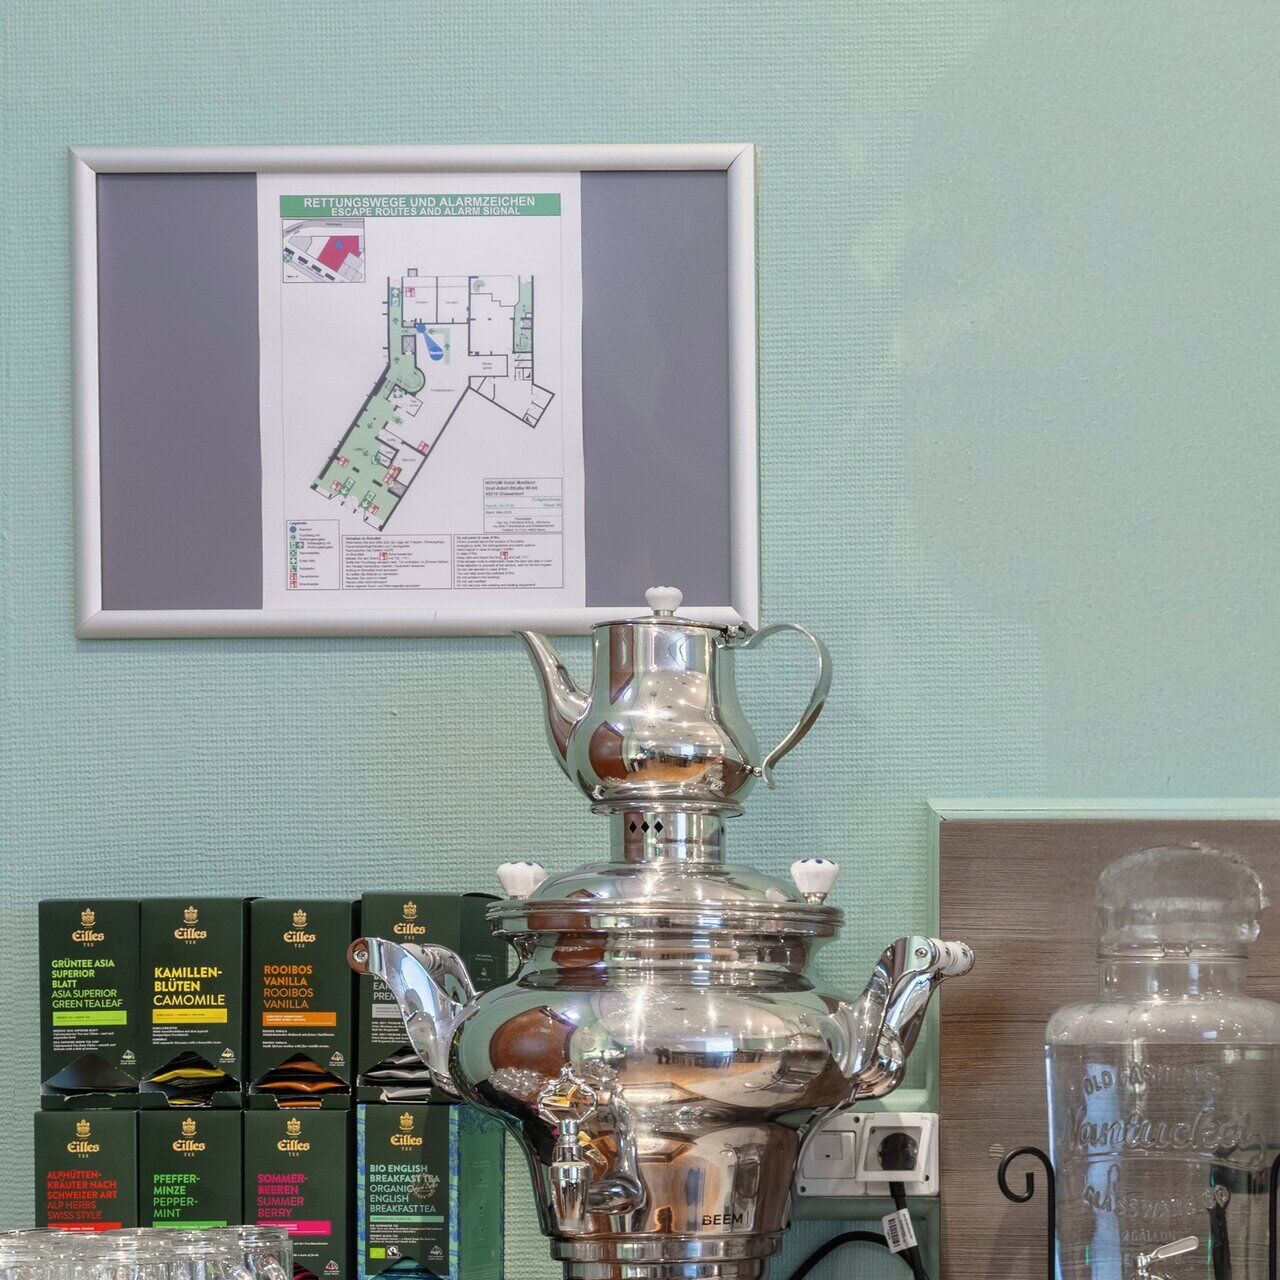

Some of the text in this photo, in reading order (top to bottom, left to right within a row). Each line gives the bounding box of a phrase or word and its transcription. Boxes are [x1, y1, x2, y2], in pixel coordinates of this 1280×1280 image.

[304, 196, 535, 208] RETTUNGSWEGE UND ALARMZEICHEN
[331, 206, 521, 216] ESCAPE ROUTES AND ALARM SIGNAL
[174, 927, 207, 940] Eilles
[393, 923, 426, 935] Eilles
[71, 929, 105, 942] Eilles
[283, 930, 316, 943] Eilles
[51, 958, 115, 968] GRÜNTEE ASIA
[51, 969, 95, 978] SUPERIOR
[154, 967, 223, 979] KAMILLEN-
[263, 965, 313, 975] ROOIBOS
[52, 980, 77, 988] BLATT
[154, 979, 200, 992] BLÜTEN
[263, 976, 308, 987] VANILLA
[51, 989, 117, 999] ASIA SUPERIOR
[263, 988, 314, 998] ROOIBOS
[52, 1000, 83, 1009] GREEN
[153, 994, 226, 1006] CAMOMILE
[263, 999, 309, 1009] VANILLA
[390, 1133, 423, 1146] Eilles
[67, 1141, 100, 1153] Eilles
[172, 1139, 206, 1152] Eilles
[277, 1139, 310, 1151] Eilles
[370, 1164, 428, 1173] BIO ENGLISH
[47, 1169, 102, 1179] ALPHÜTTEN-
[154, 1174, 201, 1184] PFEFFER-
[257, 1173, 309, 1183] SOMMER-
[370, 1175, 440, 1183] BREAKFAST TEA
[47, 1179, 117, 1190] KRÄUTER NACH
[369, 1184, 413, 1193] ORGANIC
[47, 1190, 118, 1200] SCHWEIZER ART
[154, 1185, 186, 1195] MINZE
[257, 1185, 299, 1195] BEEREN
[153, 1197, 199, 1207] PEPPER-
[257, 1197, 304, 1206] SUMMER
[370, 1195, 409, 1203] ENGLISH
[47, 1201, 97, 1210] ALP HERBS
[370, 1204, 437, 1213] BREAKFAST TEA
[47, 1211, 102, 1220] SWISS STYLE
[154, 1209, 181, 1218] MINT
[257, 1208, 293, 1218] BERRY
[702, 1213, 743, 1226] BEEM
